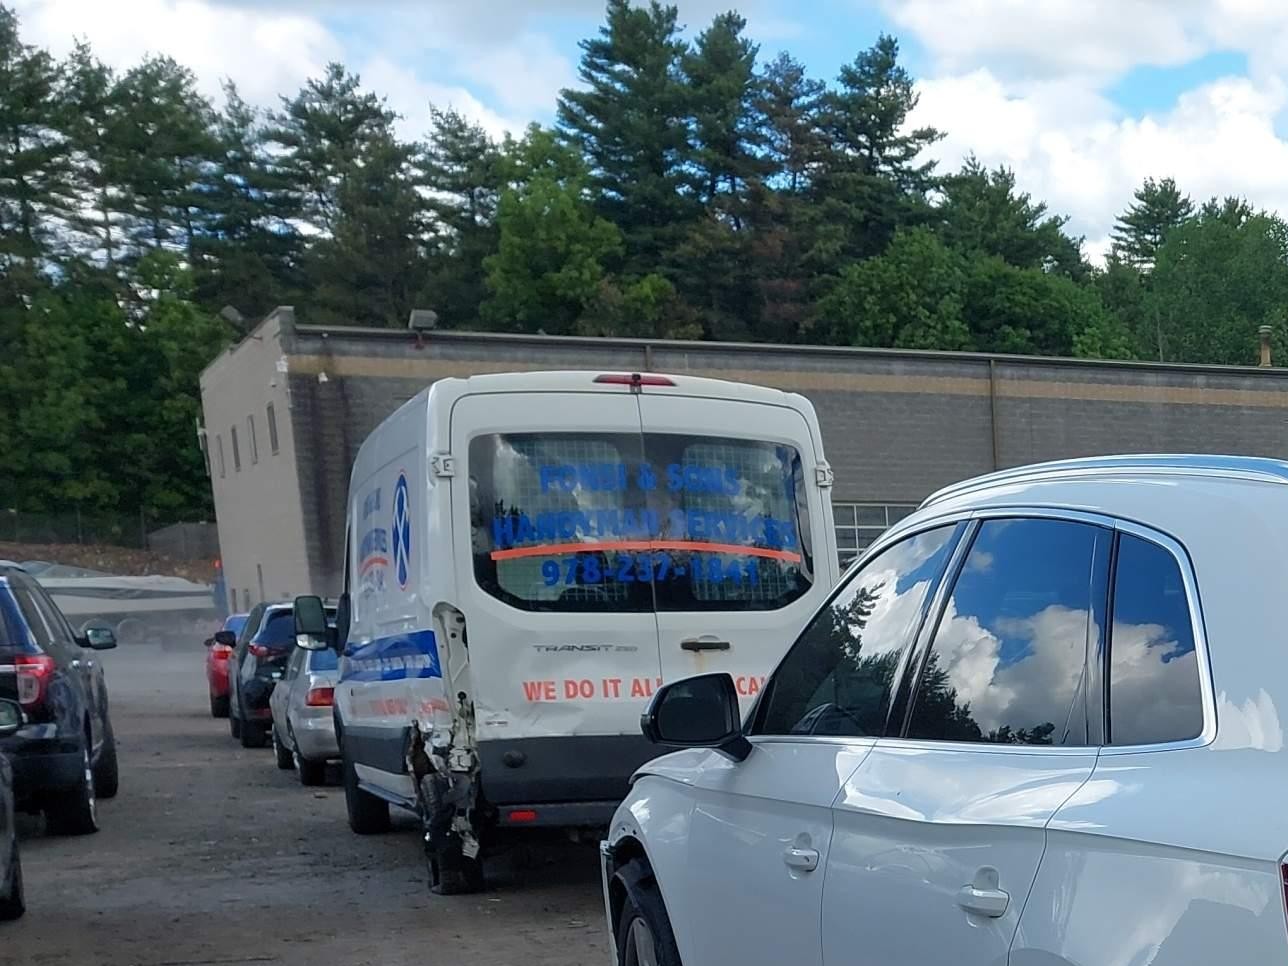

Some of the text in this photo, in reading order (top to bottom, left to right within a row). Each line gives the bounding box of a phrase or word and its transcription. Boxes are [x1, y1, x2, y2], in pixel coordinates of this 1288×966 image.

[533, 644, 613, 653] TRANSIT
[523, 681, 556, 700] WE
[564, 679, 595, 699] DO
[603, 678, 622, 697] IT
